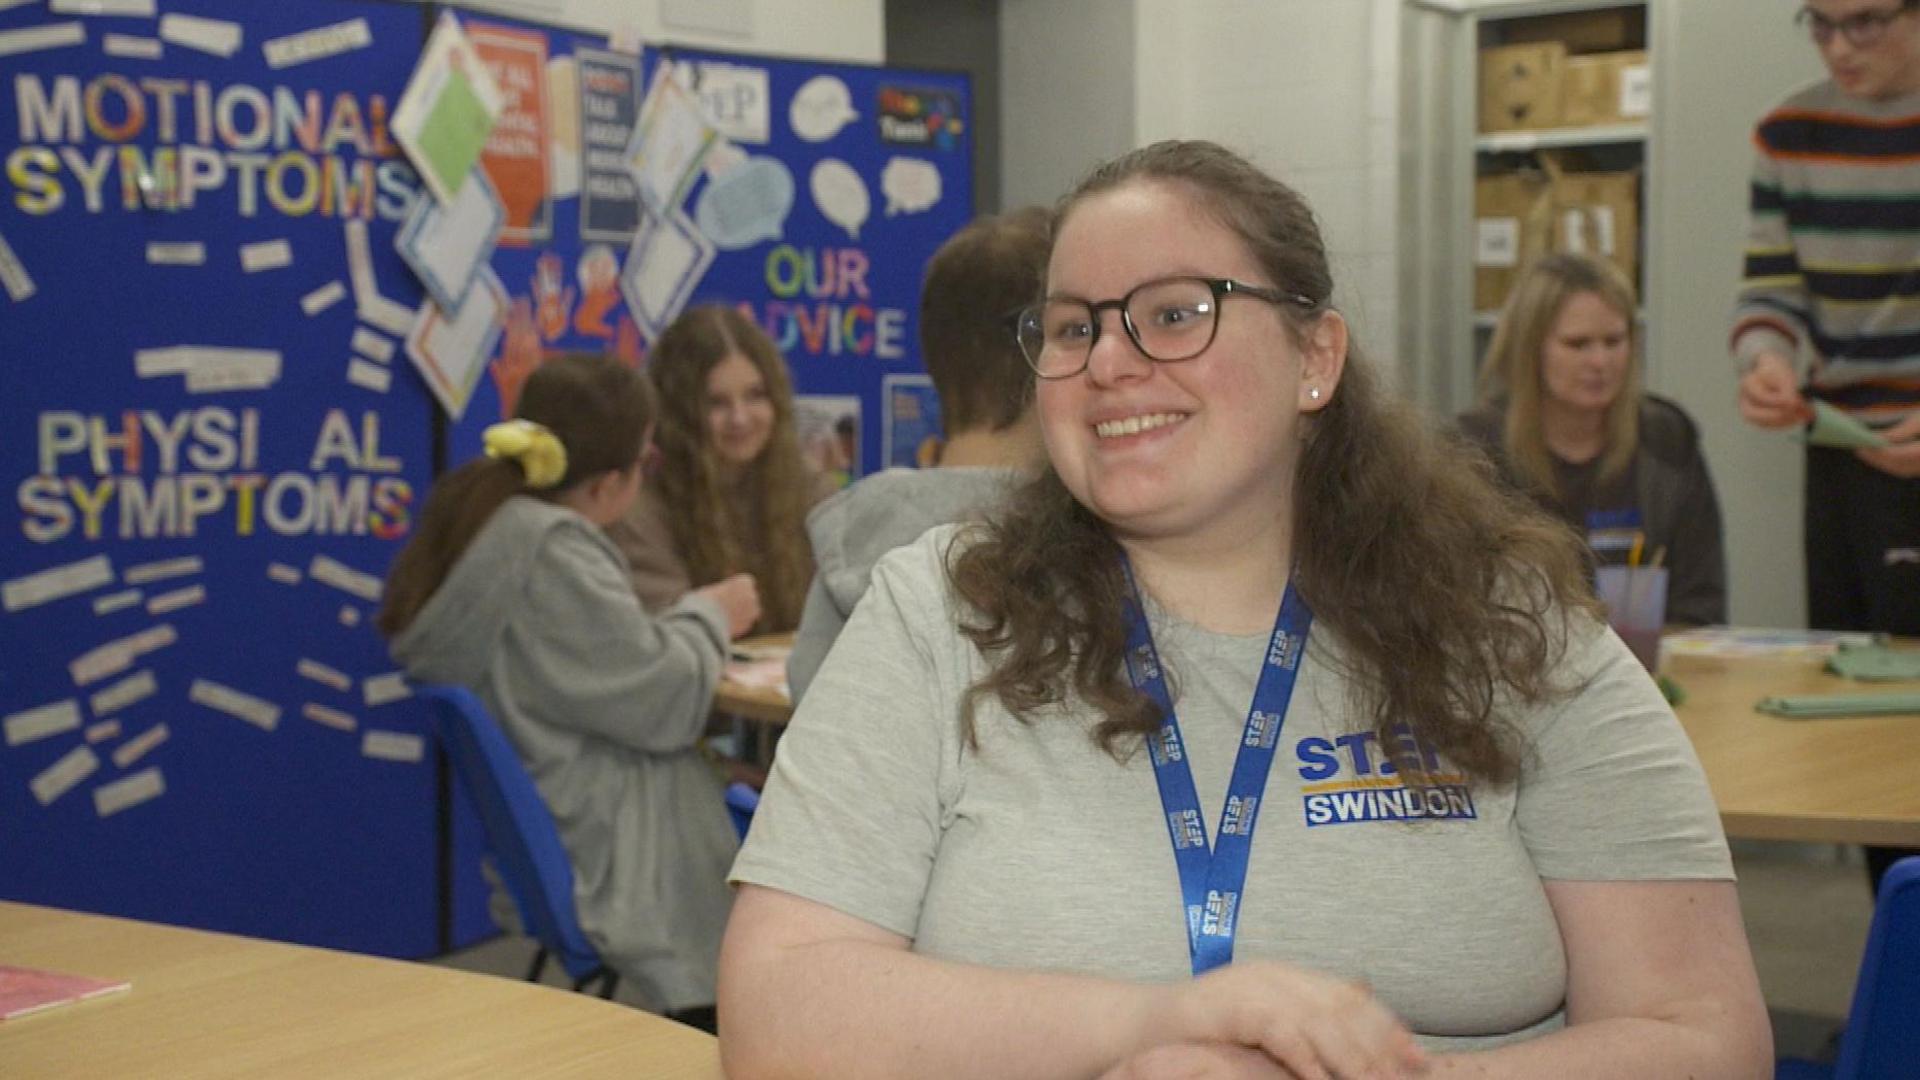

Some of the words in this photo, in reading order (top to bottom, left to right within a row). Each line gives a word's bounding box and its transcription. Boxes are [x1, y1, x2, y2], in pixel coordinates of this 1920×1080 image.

[14, 73, 399, 158] MOTIONAL
[7, 142, 419, 221] SYMPTOMS
[765, 244, 871, 300] OUR
[737, 301, 907, 361] DVICE
[38, 405, 259, 475] PHYSI
[309, 408, 402, 472] AL
[17, 471, 413, 543] SYMPTOMS
[1268, 629, 1289, 667] STEP
[1245, 710, 1266, 747] STEP
[1183, 809, 1204, 846] STEP
[1222, 795, 1243, 834] STEP
[1307, 788, 1474, 825] SWINDON
[1202, 890, 1223, 935] STEP
